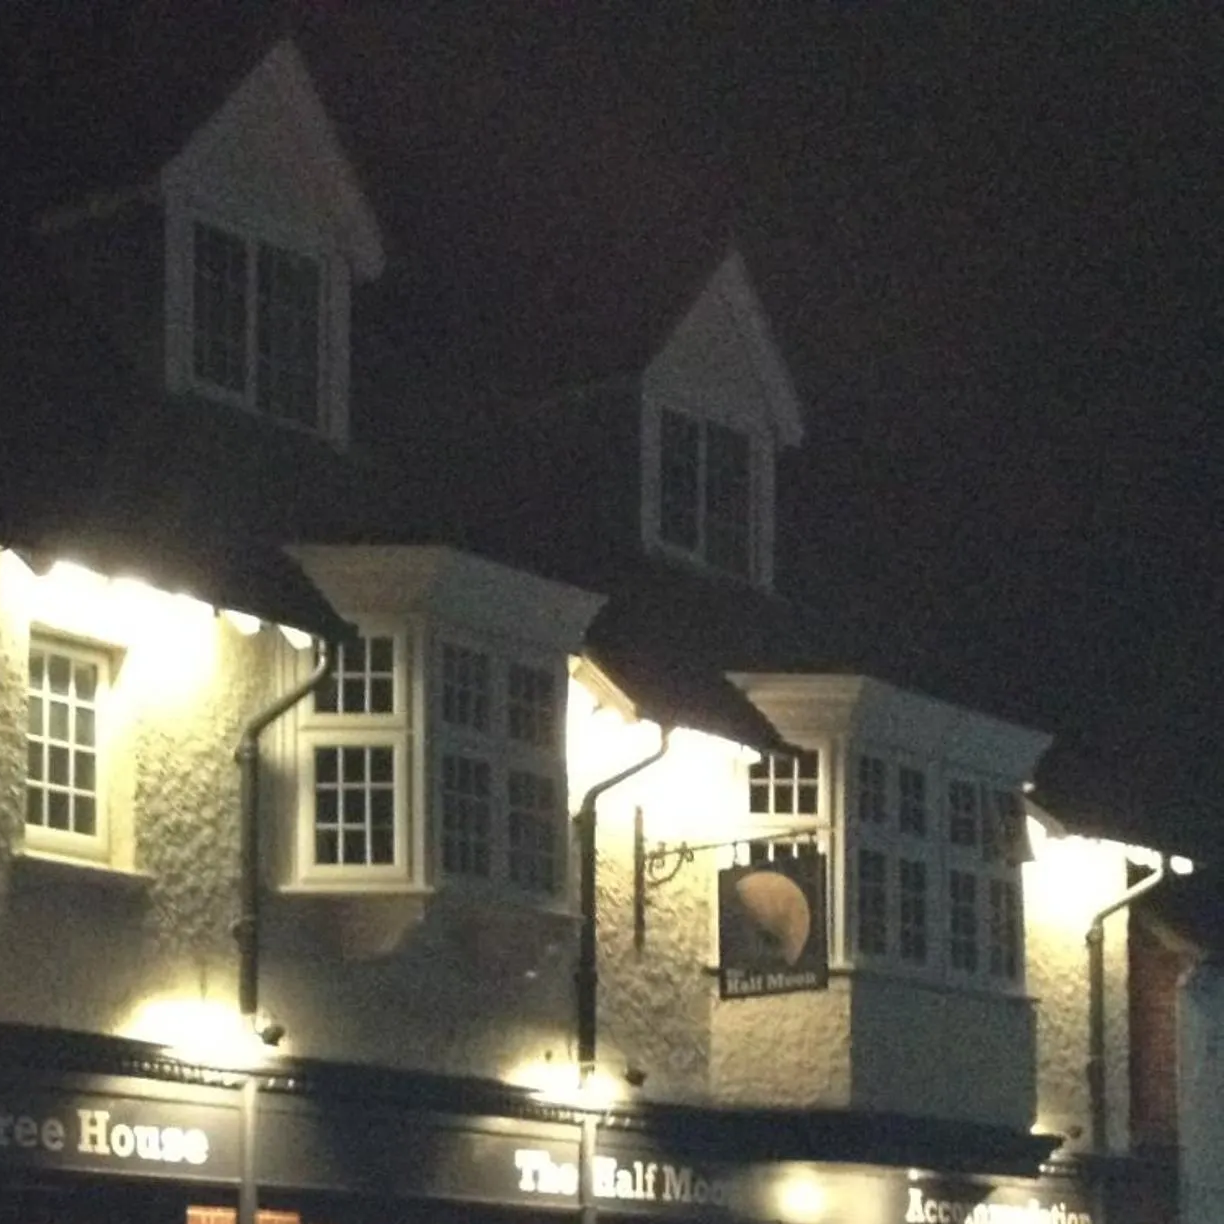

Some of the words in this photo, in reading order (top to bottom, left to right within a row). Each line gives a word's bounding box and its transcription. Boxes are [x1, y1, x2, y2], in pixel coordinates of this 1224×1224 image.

[77, 1109, 209, 1165] House
[515, 1149, 578, 1195] The
[592, 1155, 657, 1200] Half
[662, 1164, 740, 1207] Moo
